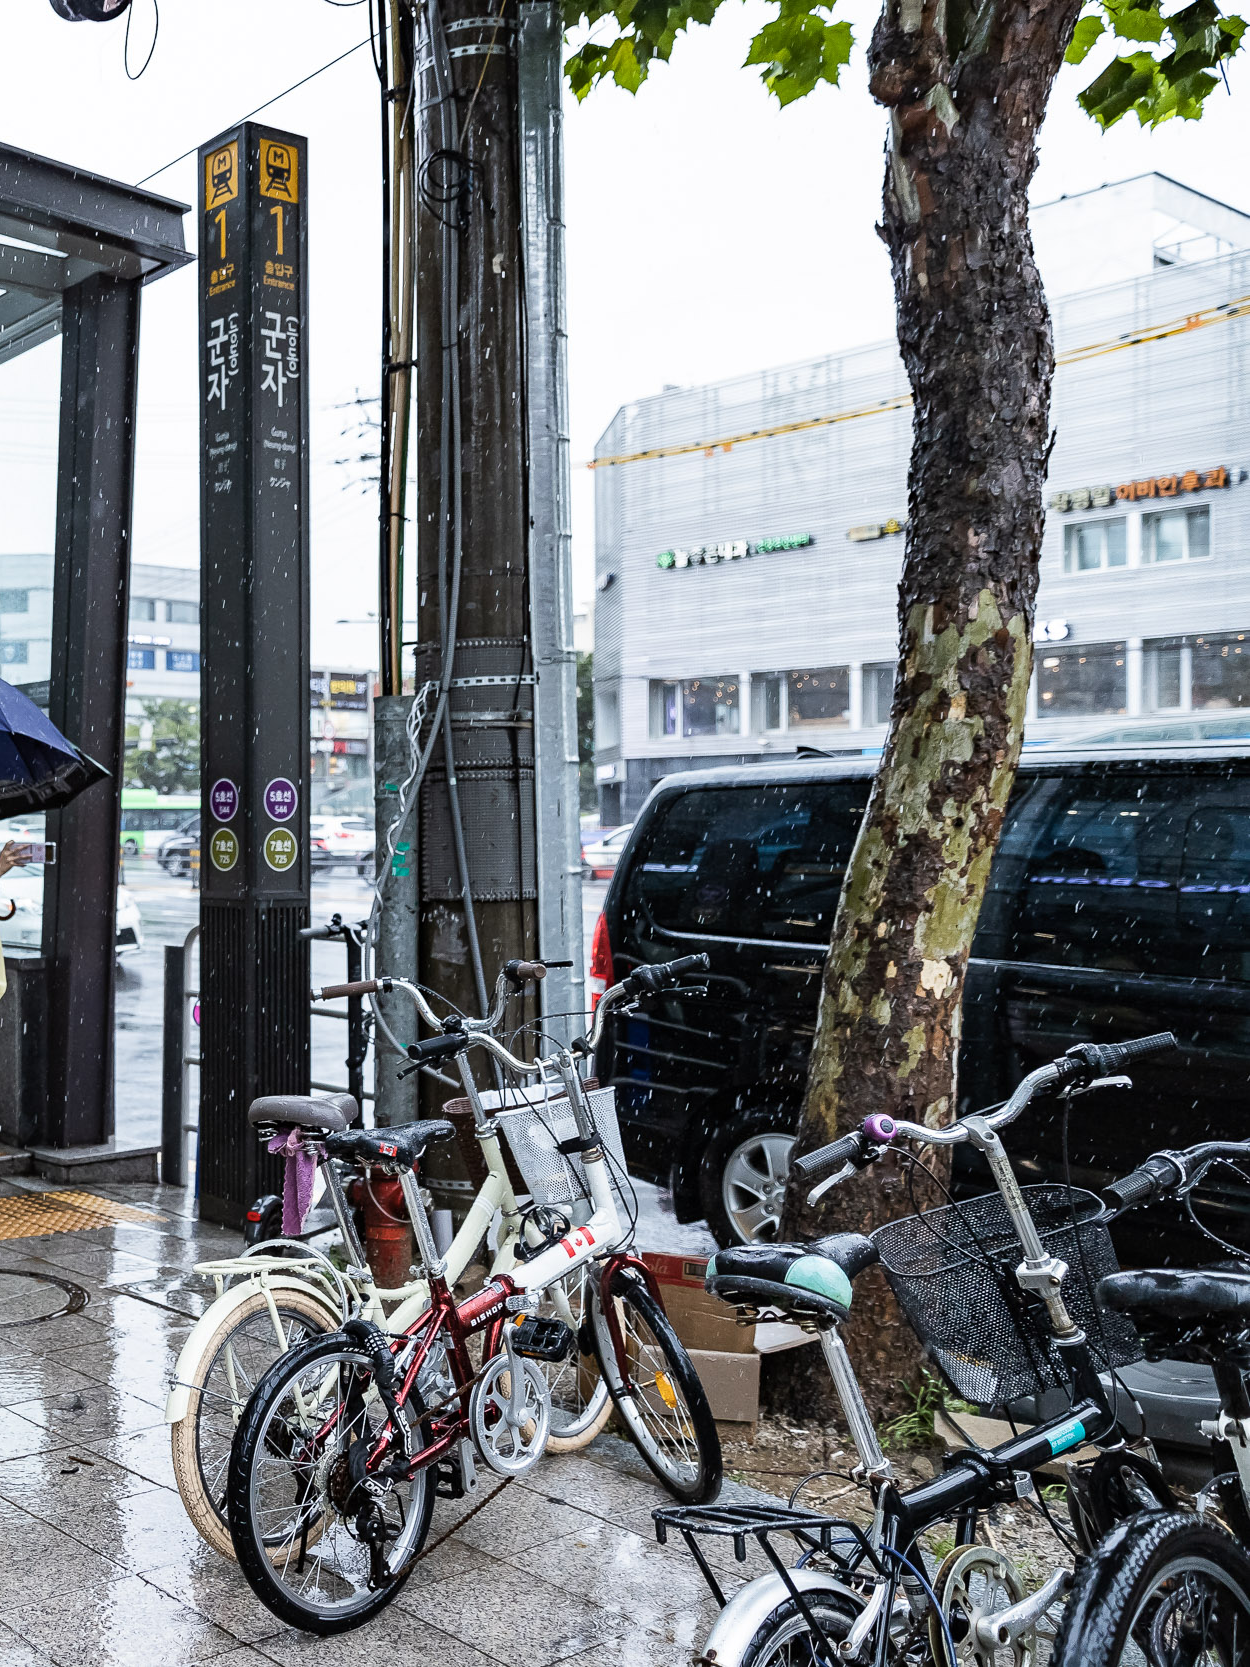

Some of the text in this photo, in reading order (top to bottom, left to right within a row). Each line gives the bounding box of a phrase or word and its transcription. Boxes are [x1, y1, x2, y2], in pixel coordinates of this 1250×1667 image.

[214, 209, 226, 259] 1
[270, 206, 284, 255] 1
[264, 260, 294, 278] 출입구
[263, 274, 295, 291] Entrance
[207, 317, 230, 411] 군자
[261, 311, 287, 408] 군자
[1116, 465, 1226, 501] 이비인후과
[215, 790, 234, 803] 5호선
[270, 790, 291, 803] 5호선
[219, 806, 230, 815] 544
[274, 805, 287, 815] 544
[215, 840, 234, 852] 7호선
[270, 840, 291, 852] 7호선
[219, 854, 230, 864] 725
[274, 854, 287, 864] 725
[470, 1302, 503, 1326] BISHOP
